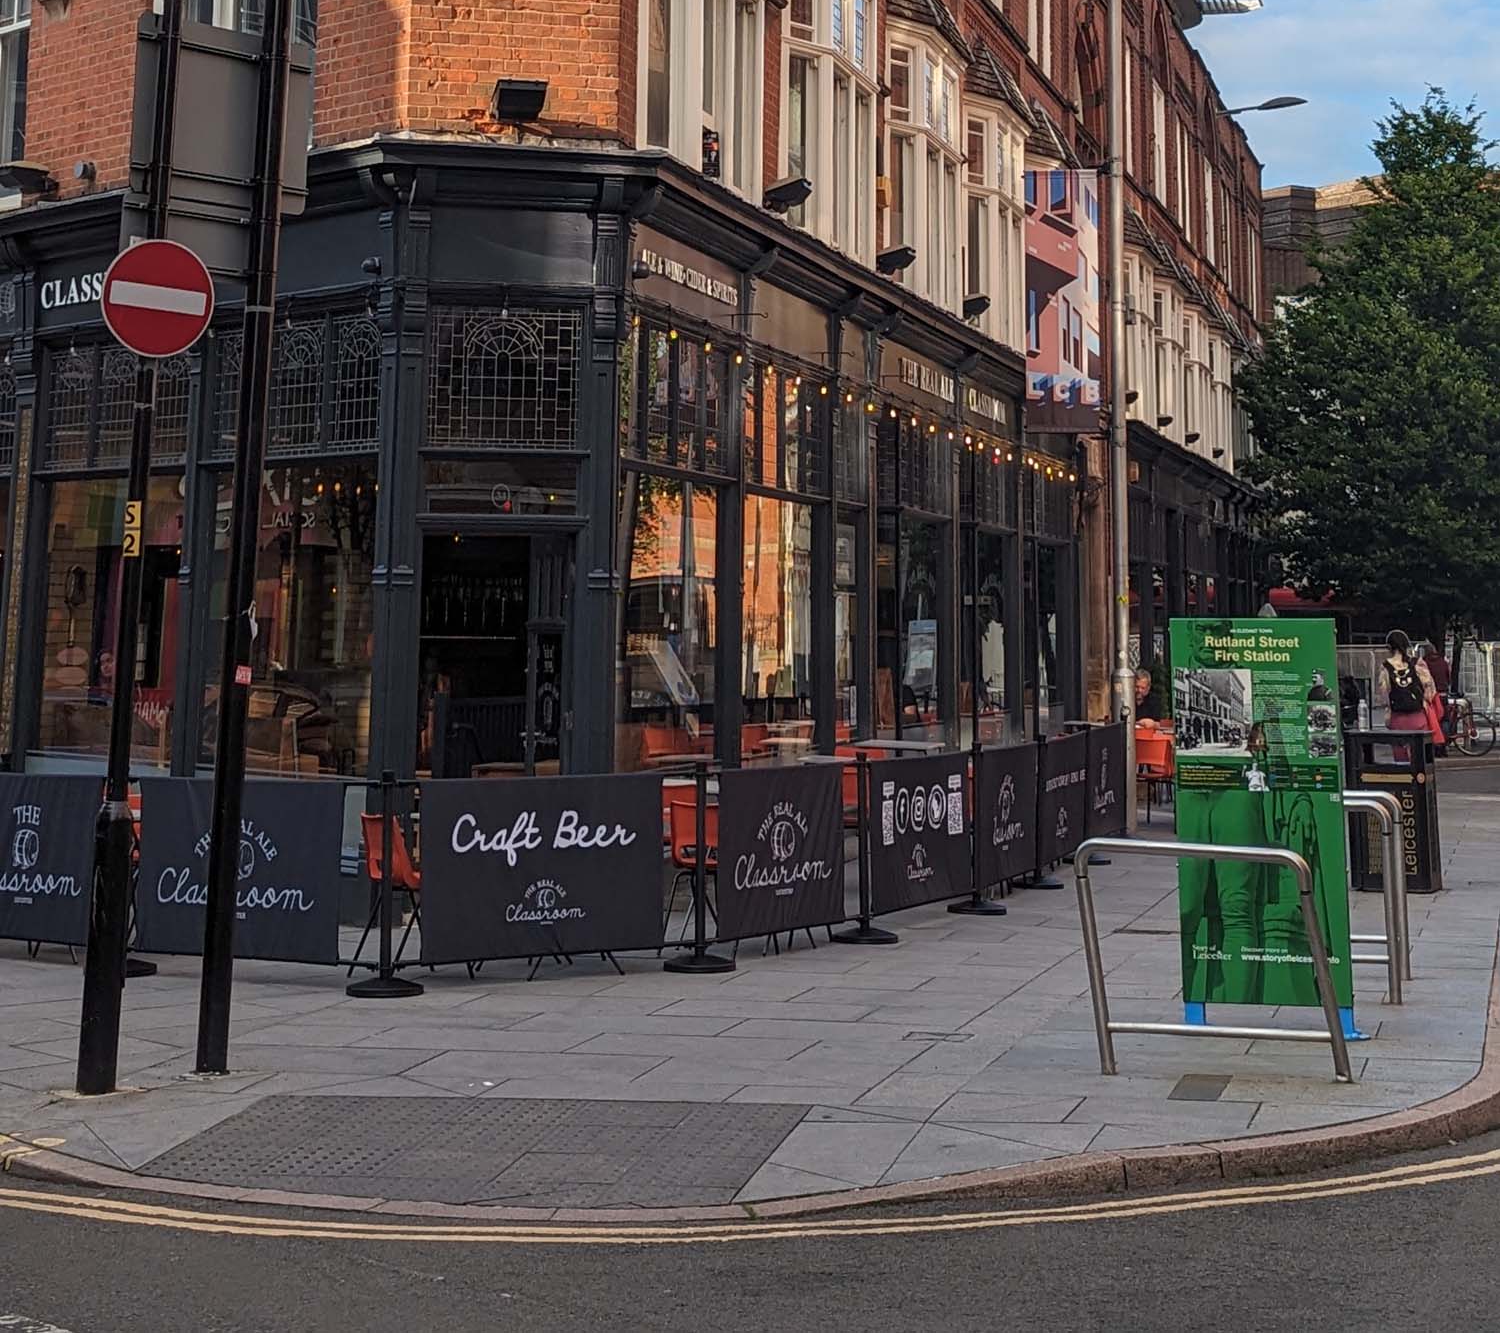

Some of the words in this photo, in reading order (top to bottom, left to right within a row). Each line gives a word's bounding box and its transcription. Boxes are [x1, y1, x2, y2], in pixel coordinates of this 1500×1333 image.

[642, 249, 657, 272] ALE
[686, 268, 707, 293] CIDER
[707, 278, 713, 296] &
[713, 280, 738, 306] SPIRITS
[41, 272, 107, 308] CLASS
[902, 356, 919, 388] THE
[920, 364, 940, 396] REAL
[125, 504, 136, 525] S
[124, 534, 135, 554] 2
[1205, 636, 1255, 648] Rutland
[1259, 636, 1299, 648] Street
[1215, 650, 1239, 661] Fire
[1243, 650, 1290, 662] Station
[13, 805, 41, 826] THE
[194, 829, 212, 858] TH
[255, 830, 278, 861] ALE
[451, 811, 542, 867] Craft
[553, 810, 637, 849] Beer
[1402, 794, 1418, 875] Leicester
[0, 872, 81, 897] ssroom
[525, 884, 537, 898] THE
[537, 879, 555, 888] REAL
[555, 884, 567, 898] ALE
[506, 903, 586, 922] Classroom
[1192, 949, 1232, 961] Leicester
